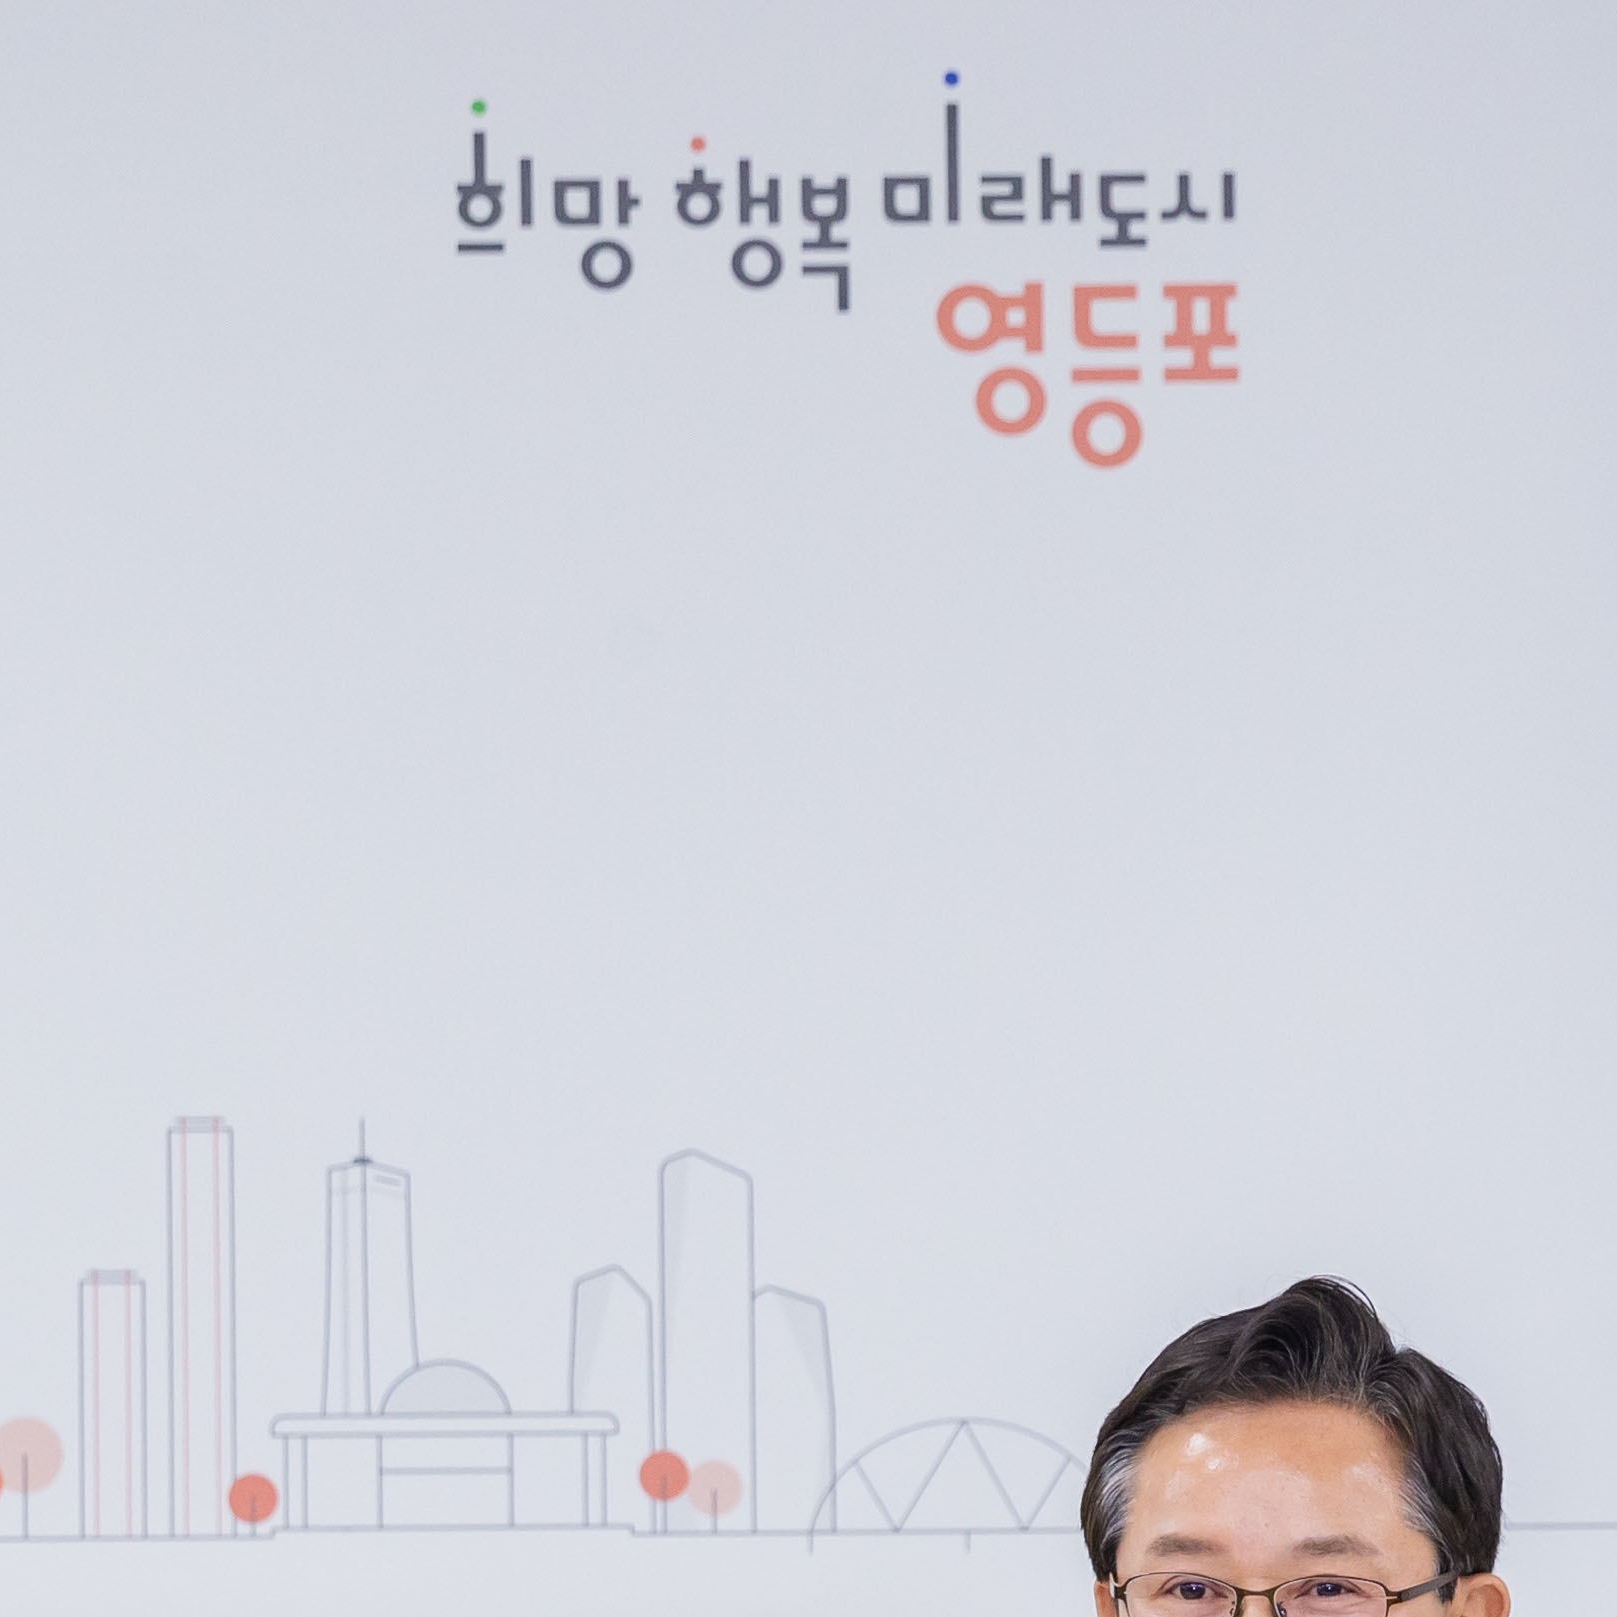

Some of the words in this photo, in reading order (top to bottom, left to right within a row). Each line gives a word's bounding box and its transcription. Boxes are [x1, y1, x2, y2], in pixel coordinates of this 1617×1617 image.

[457, 101, 641, 291] 희망
[675, 136, 851, 313] 행복
[883, 71, 1237, 249] 미래도시
[936, 282, 1240, 470] 영등포
